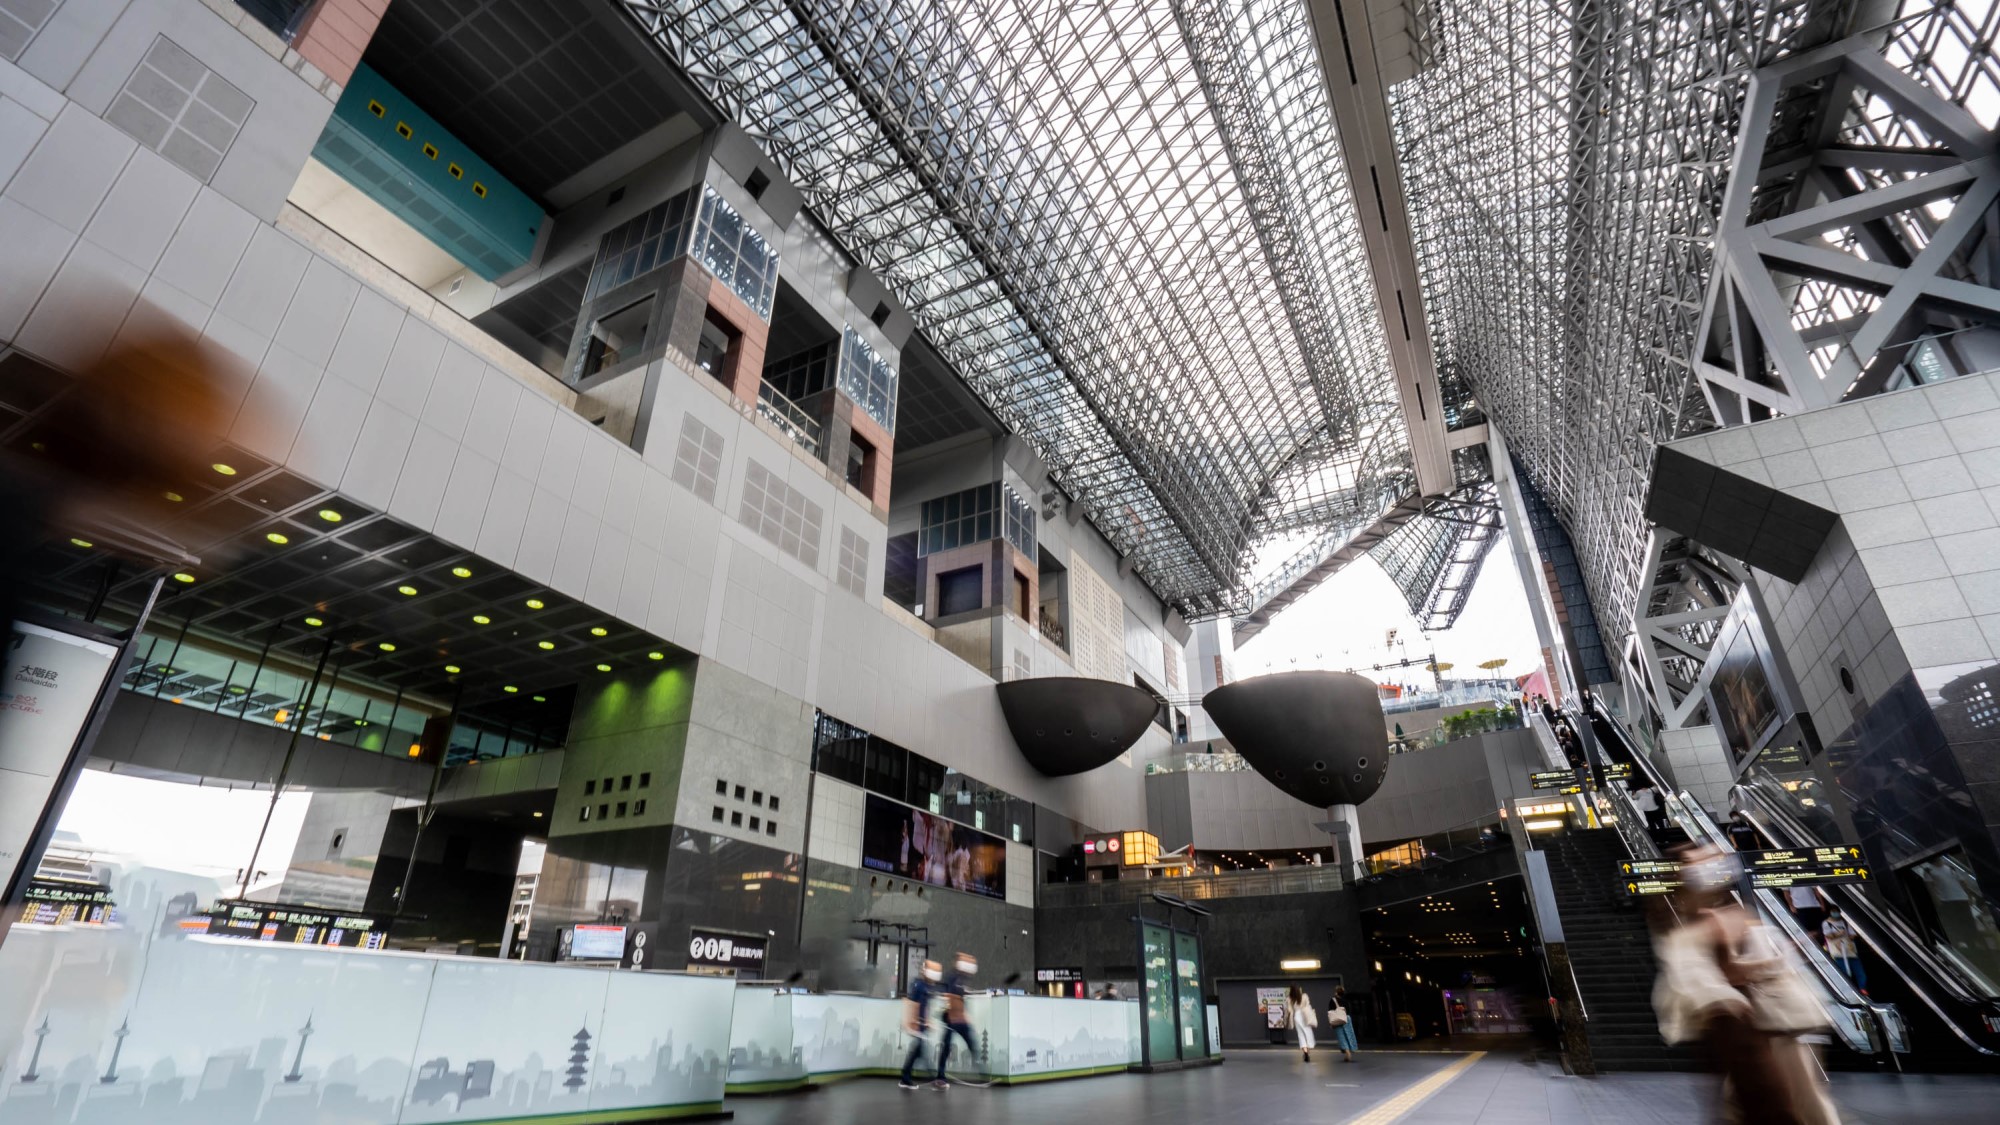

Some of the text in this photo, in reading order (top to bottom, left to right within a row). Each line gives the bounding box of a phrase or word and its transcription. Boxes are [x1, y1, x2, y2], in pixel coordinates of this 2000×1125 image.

[19, 664, 59, 681] 大階段
[15, 673, 58, 689] Daikaidan
